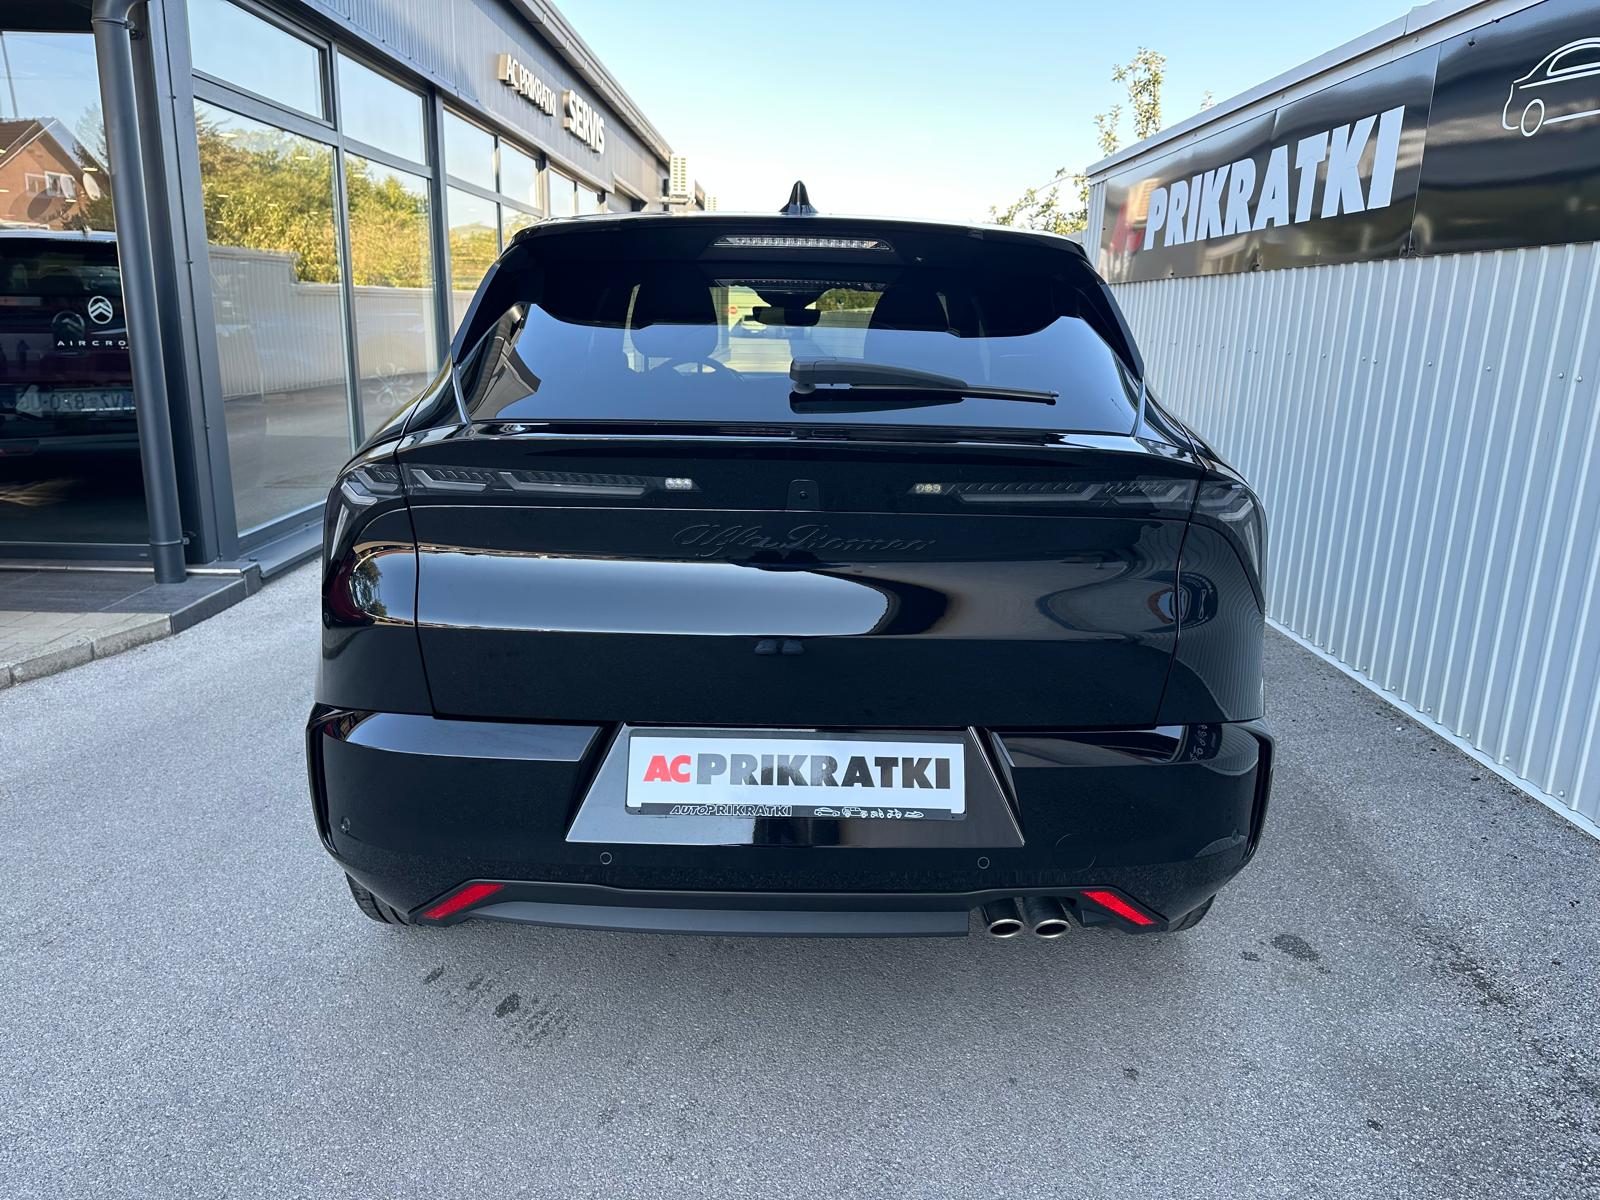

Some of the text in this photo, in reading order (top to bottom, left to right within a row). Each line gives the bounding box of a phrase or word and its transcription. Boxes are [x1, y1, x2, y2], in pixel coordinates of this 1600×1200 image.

[564, 90, 604, 154] SERVIS
[1143, 105, 1406, 250] PRIKRATKI
[671, 524, 936, 557] Alfa Romeo
